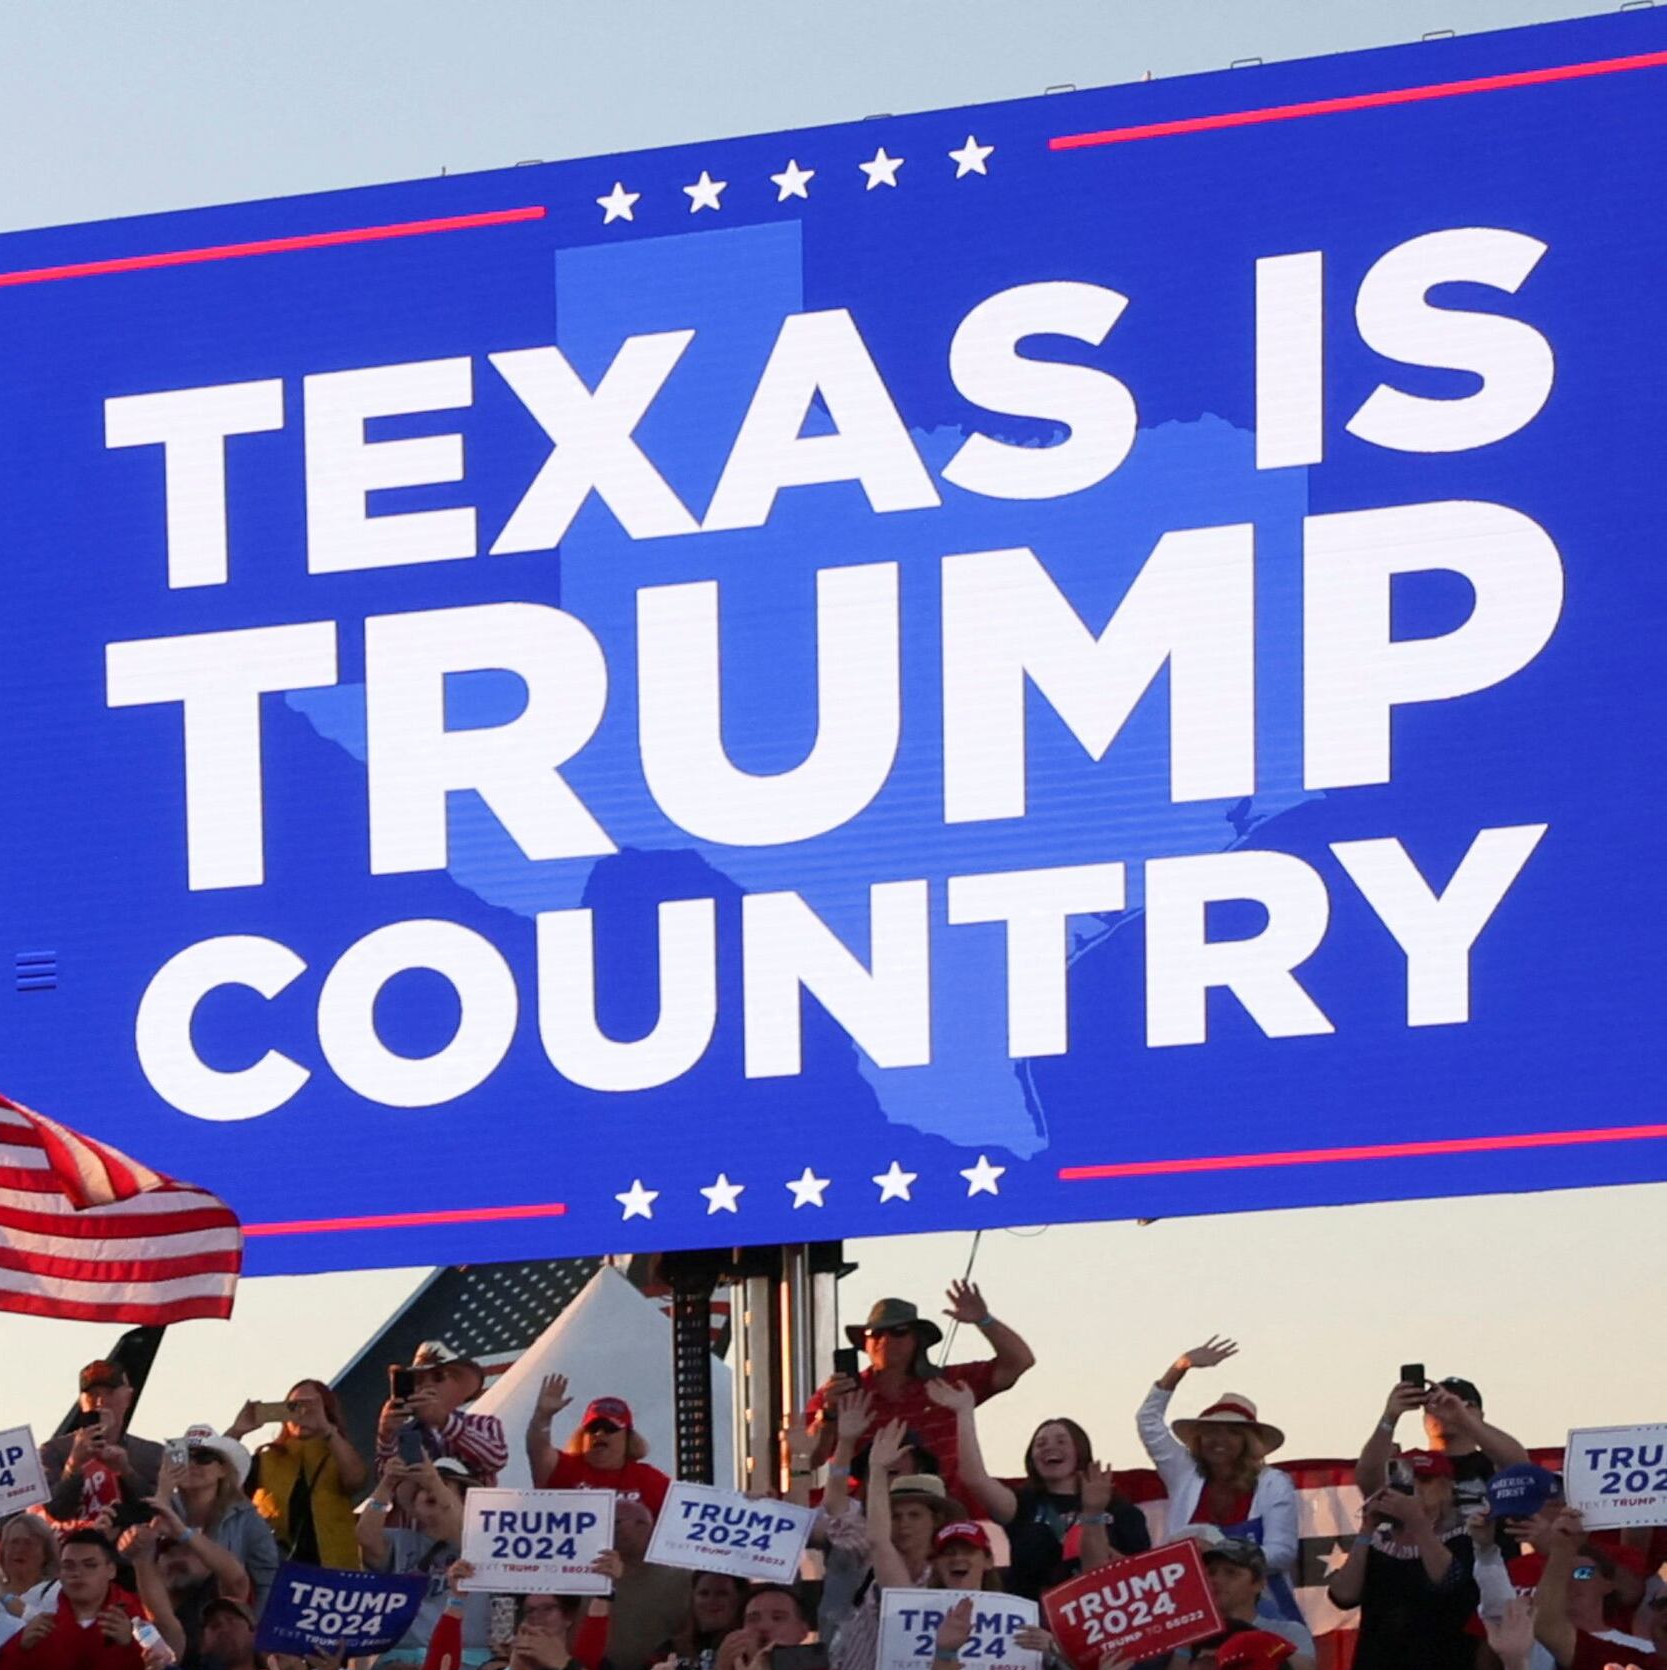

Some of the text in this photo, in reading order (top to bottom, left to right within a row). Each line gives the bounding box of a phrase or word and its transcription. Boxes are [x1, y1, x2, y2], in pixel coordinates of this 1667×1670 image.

[105, 227, 1556, 588] TEXAS IS
[105, 502, 1565, 892] TRUMP
[135, 824, 1548, 1121] COUNTRY
[1490, 1475, 1536, 1491] AMERICA
[1495, 1486, 1528, 1500] FIRST
[1611, 1497, 1658, 1508] TRUMP
[479, 1510, 597, 1535] TRUMP
[681, 1500, 796, 1535] TRUMP
[490, 1535, 578, 1560] 2024
[686, 1522, 772, 1553] 2024
[693, 1545, 733, 1557] TRUMP
[502, 1563, 540, 1573] TRUMP
[289, 1581, 408, 1614] TRUMP
[1059, 1562, 1186, 1627] TRUMP
[295, 1608, 383, 1636] 2024
[898, 1609, 1026, 1636] TRMP
[1082, 1591, 1178, 1646] 2024
[913, 1634, 1007, 1660] 224
[1099, 1631, 1144, 1651] TRUMP
